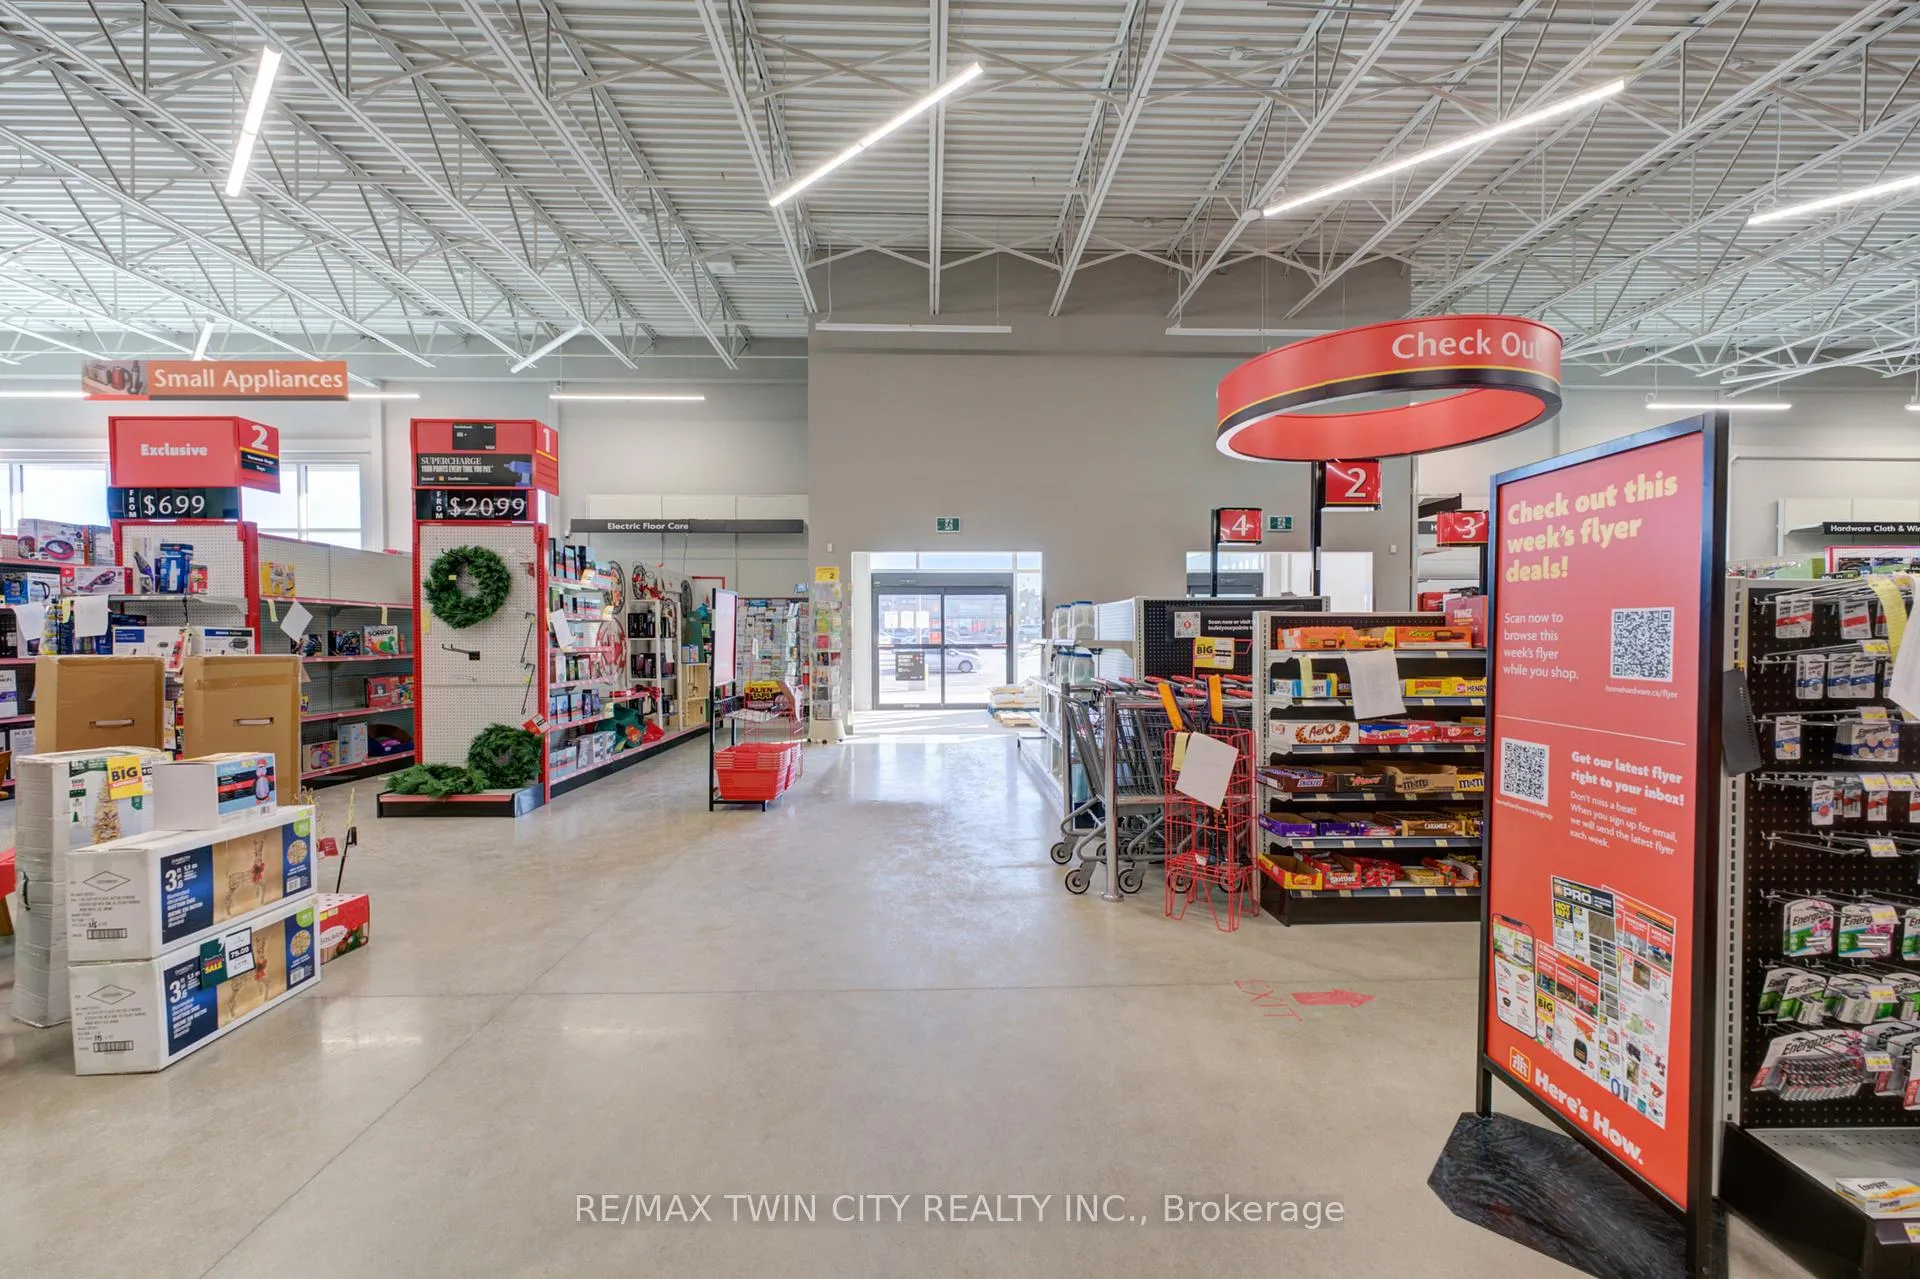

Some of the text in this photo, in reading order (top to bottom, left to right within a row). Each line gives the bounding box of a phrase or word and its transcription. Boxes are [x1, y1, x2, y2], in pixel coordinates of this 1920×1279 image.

[1392, 329, 1542, 361] Check Out
[154, 369, 343, 393] Small Appliances
[251, 425, 269, 451] 2
[543, 428, 551, 453] 1
[140, 443, 208, 457] Exclusive
[421, 457, 482, 465] SUPERCHARGE
[1344, 467, 1367, 498] 2
[143, 495, 205, 516] $6.99
[449, 496, 525, 517] $20.99
[1507, 470, 1678, 525] Check out this
[607, 522, 689, 530] Electric Floor Care
[1231, 514, 1249, 537] 4
[1462, 516, 1476, 539] 3
[1580, 516, 1643, 549] flyer
[1830, 524, 1872, 532] Hardware
[1873, 524, 1896, 532] Cloth
[1505, 555, 1569, 583] deals!
[1504, 612, 1564, 624] Scan now to
[1504, 628, 1559, 641] browse this
[1196, 645, 1214, 655] BIG
[1536, 646, 1559, 663] flyer
[1503, 663, 1579, 682] while you shop.
[111, 766, 138, 781] BIG
[1571, 751, 1683, 785] Get our latest flyer
[1571, 769, 1685, 806] right to your inbox!
[1591, 797, 1608, 808] miss
[1615, 801, 1637, 816] beat!
[1570, 803, 1592, 817] When
[1593, 810, 1608, 820] you
[1609, 815, 1625, 827] sign
[1625, 821, 1637, 830] up
[1638, 822, 1651, 834] for
[1569, 829, 1610, 848] each week.
[1570, 817, 1675, 855] we will send the latest flyer
[165, 869, 178, 892] 3
[1563, 887, 1592, 905] PRO
[204, 961, 223, 975] SALE
[169, 980, 181, 1004] 3
[1537, 998, 1553, 1012] BIG
[1592, 1110, 1643, 1166] How.
